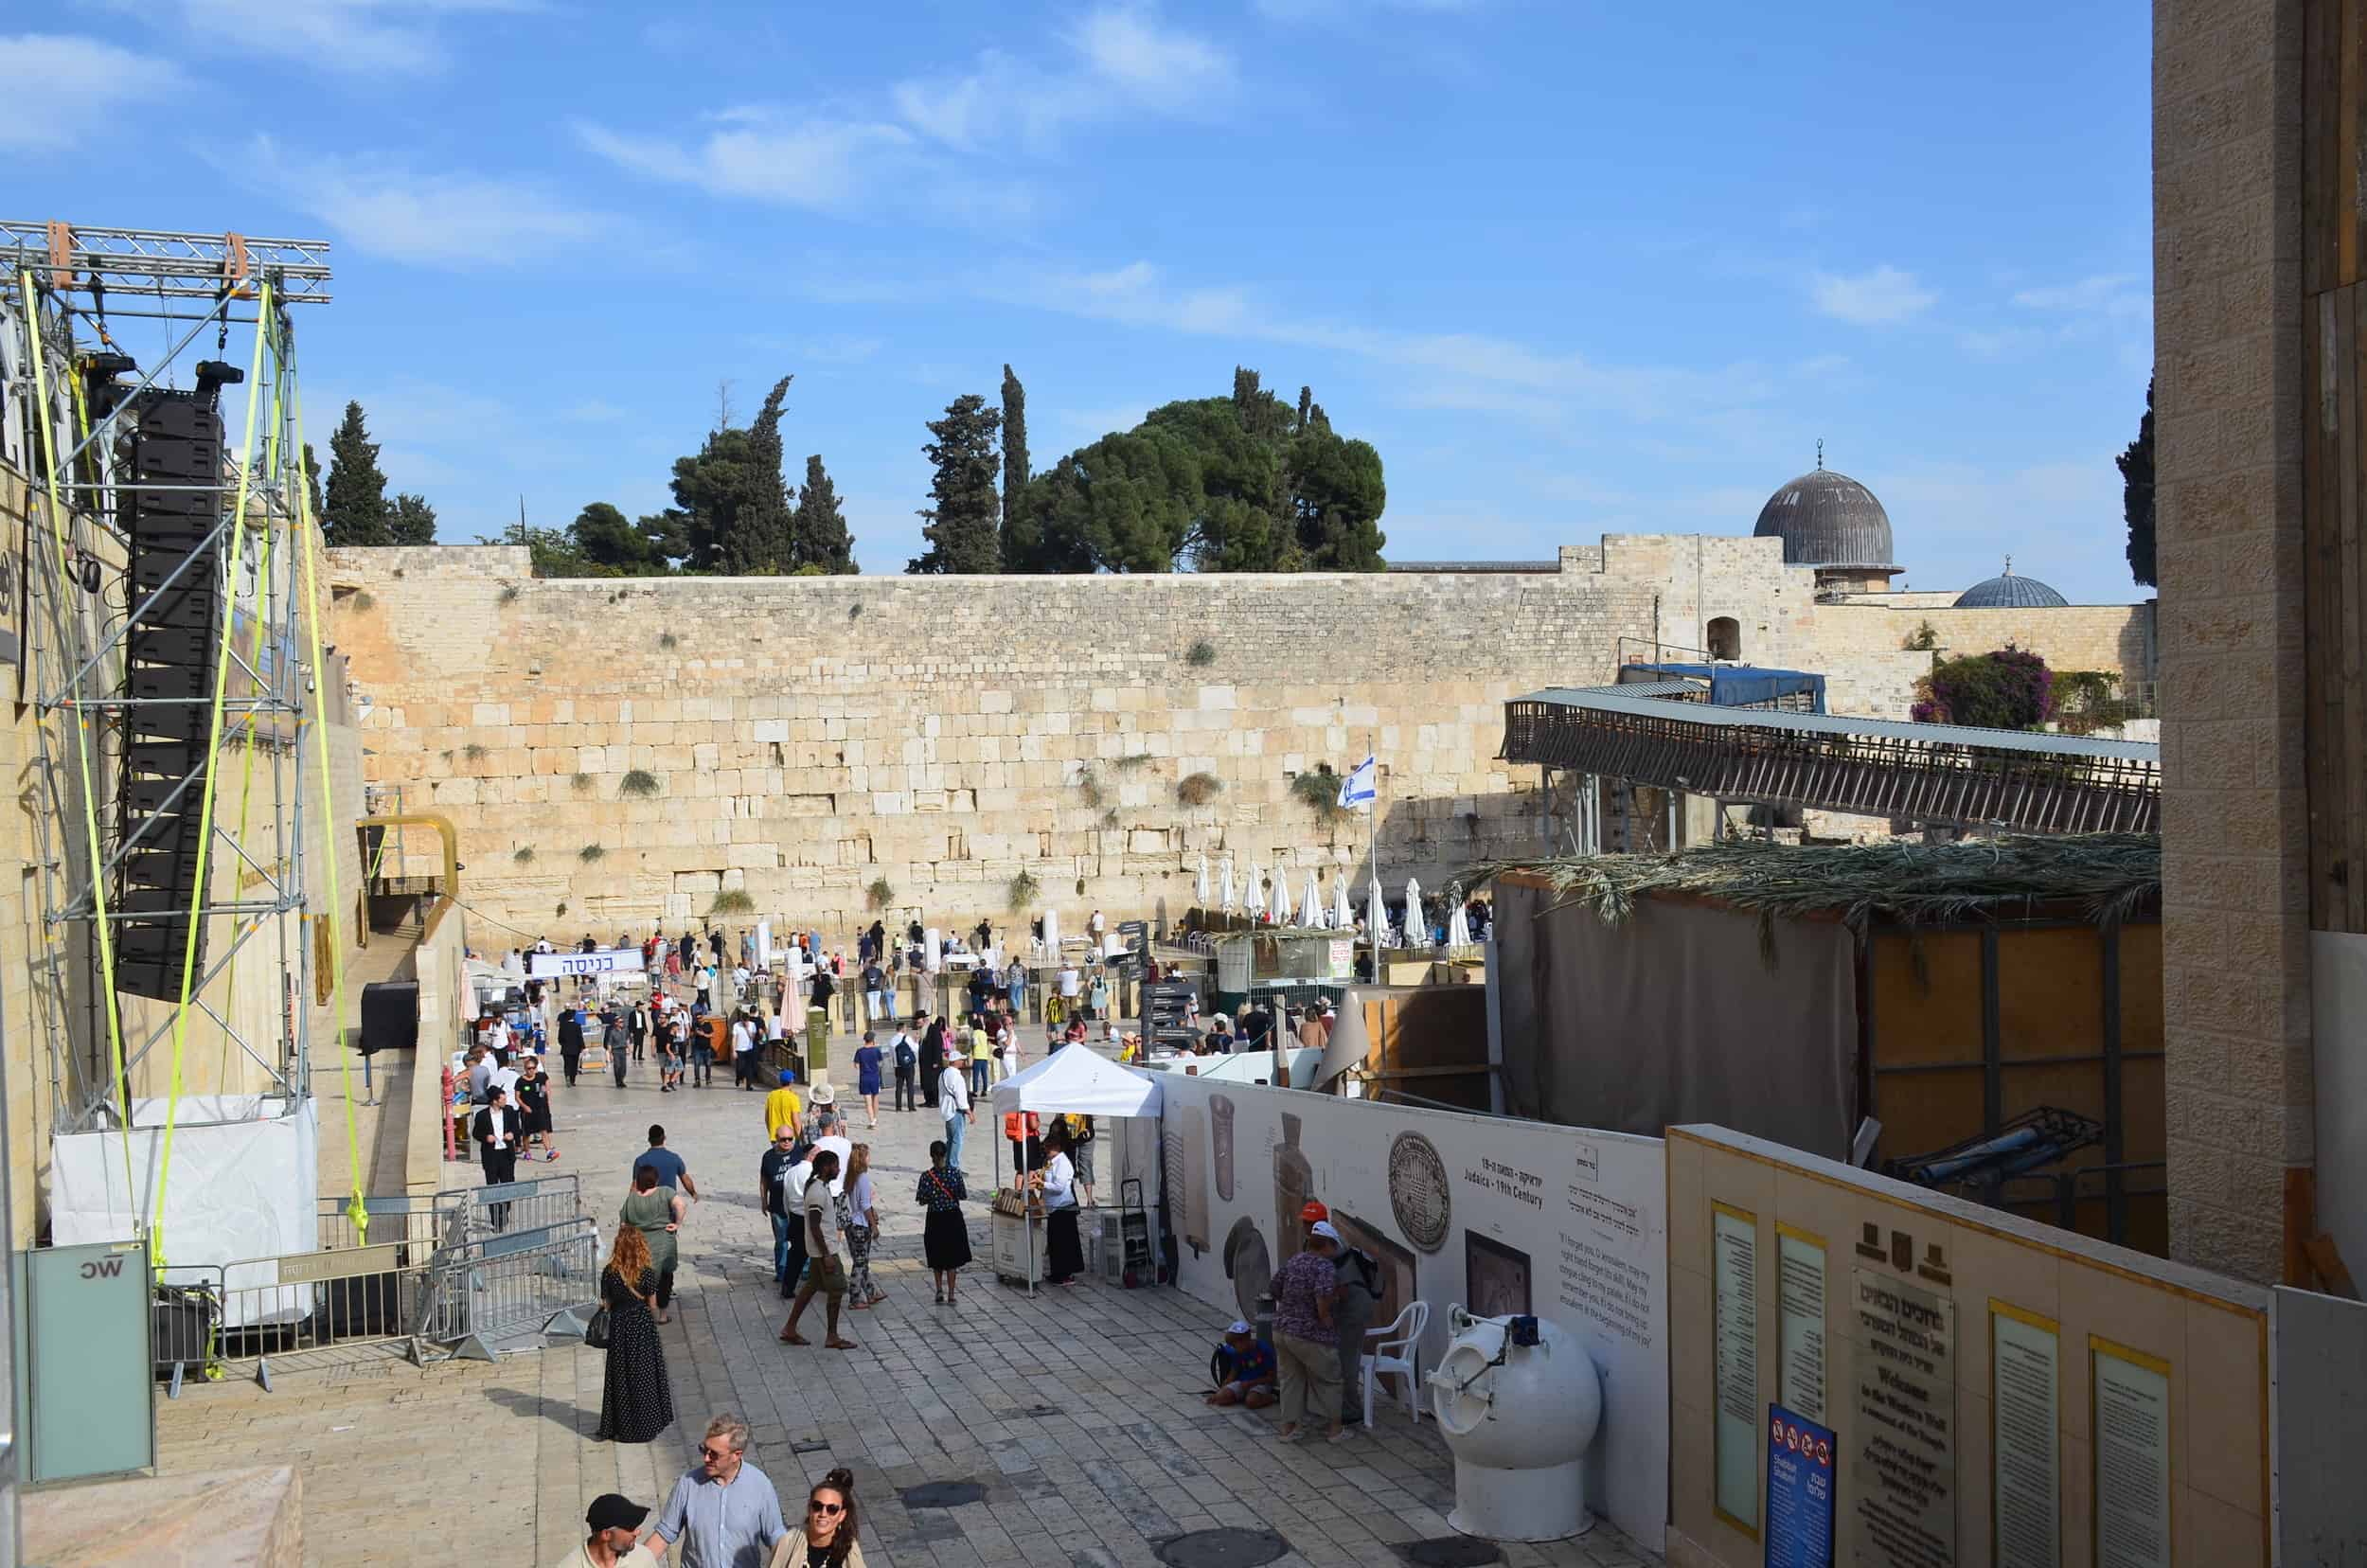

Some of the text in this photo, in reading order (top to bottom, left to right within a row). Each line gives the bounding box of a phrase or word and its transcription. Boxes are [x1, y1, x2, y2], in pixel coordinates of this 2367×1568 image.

[562, 957, 614, 973] כניסה
[1464, 1167, 1490, 1189] Judaica
[1497, 1180, 1512, 1198] 19th
[1513, 1185, 1543, 1210] Century
[1861, 1382, 1870, 1398] to
[1872, 1387, 1885, 1405] the
[1886, 1393, 1923, 1421] Western
[1878, 1365, 1927, 1402] Welcome
[1810, 1472, 1826, 1487] שבת
